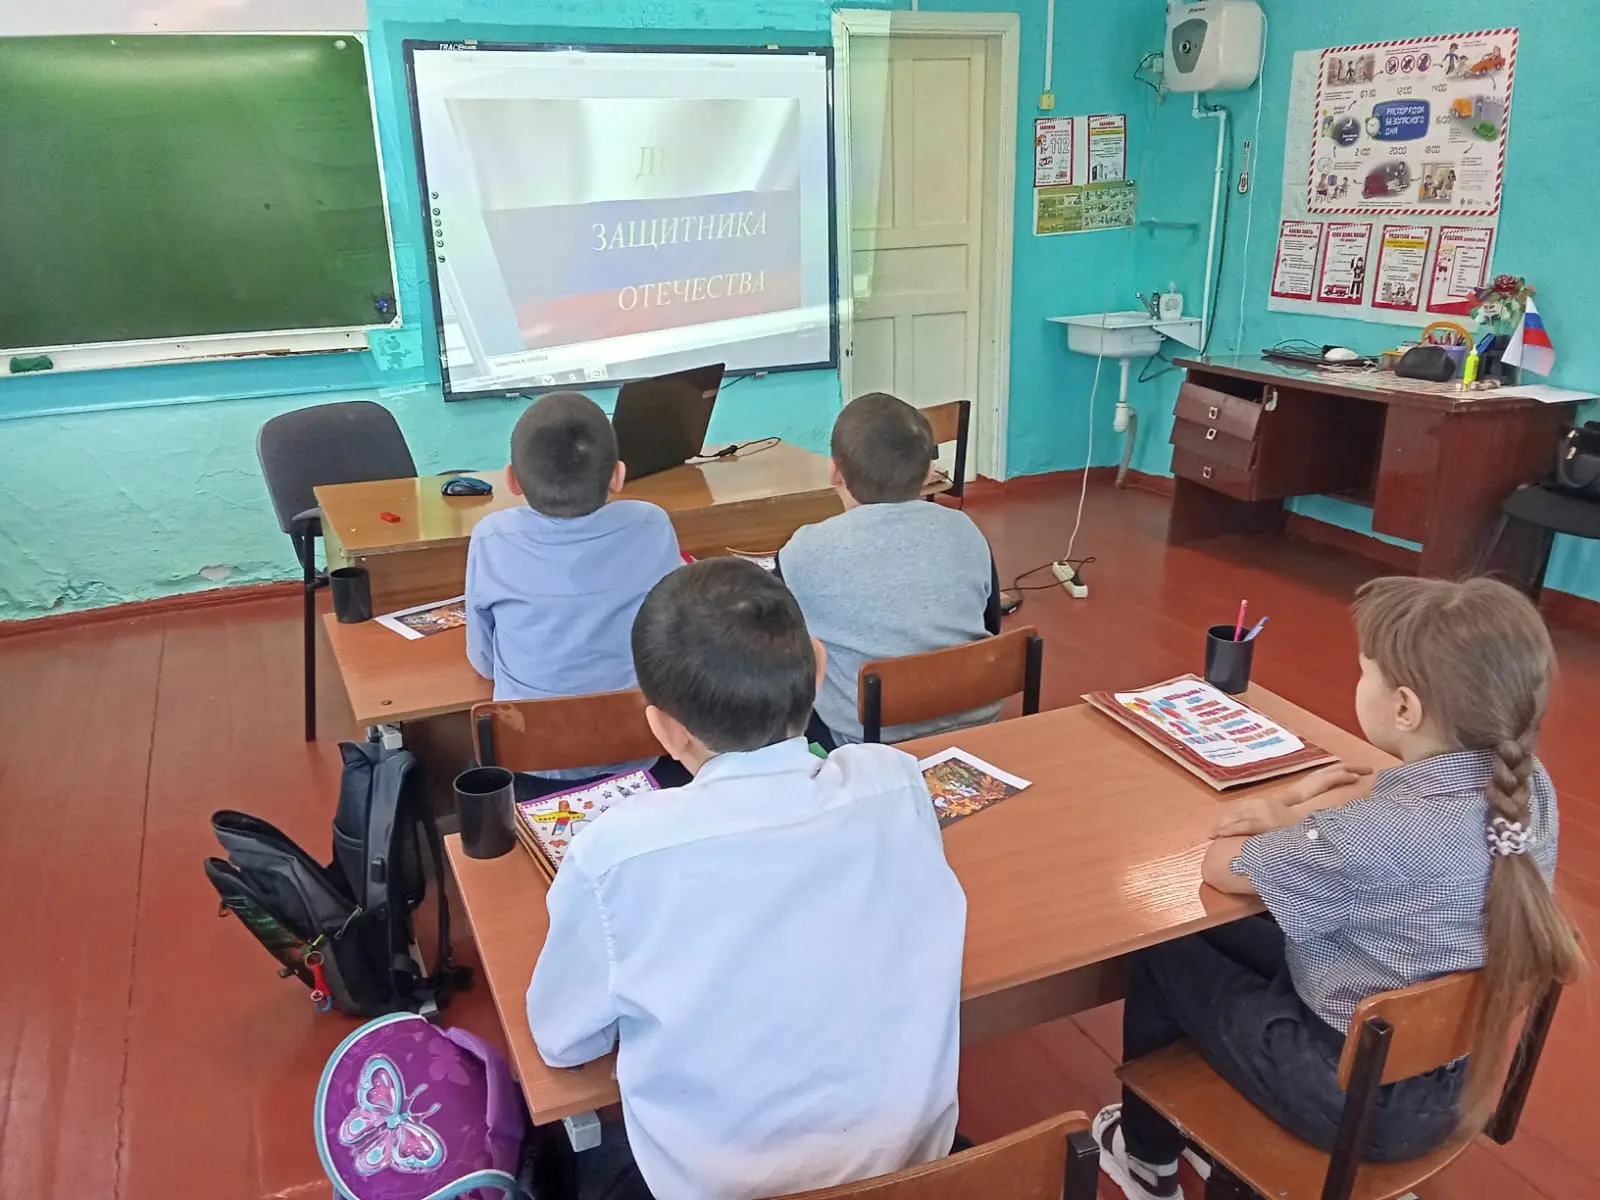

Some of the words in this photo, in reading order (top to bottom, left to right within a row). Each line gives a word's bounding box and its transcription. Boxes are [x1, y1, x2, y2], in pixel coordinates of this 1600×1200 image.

[1050, 138, 1070, 154] 112
[592, 211, 767, 251] ЗАЩИТНИКА
[618, 269, 765, 311] ОТЕЧЕСТВА
